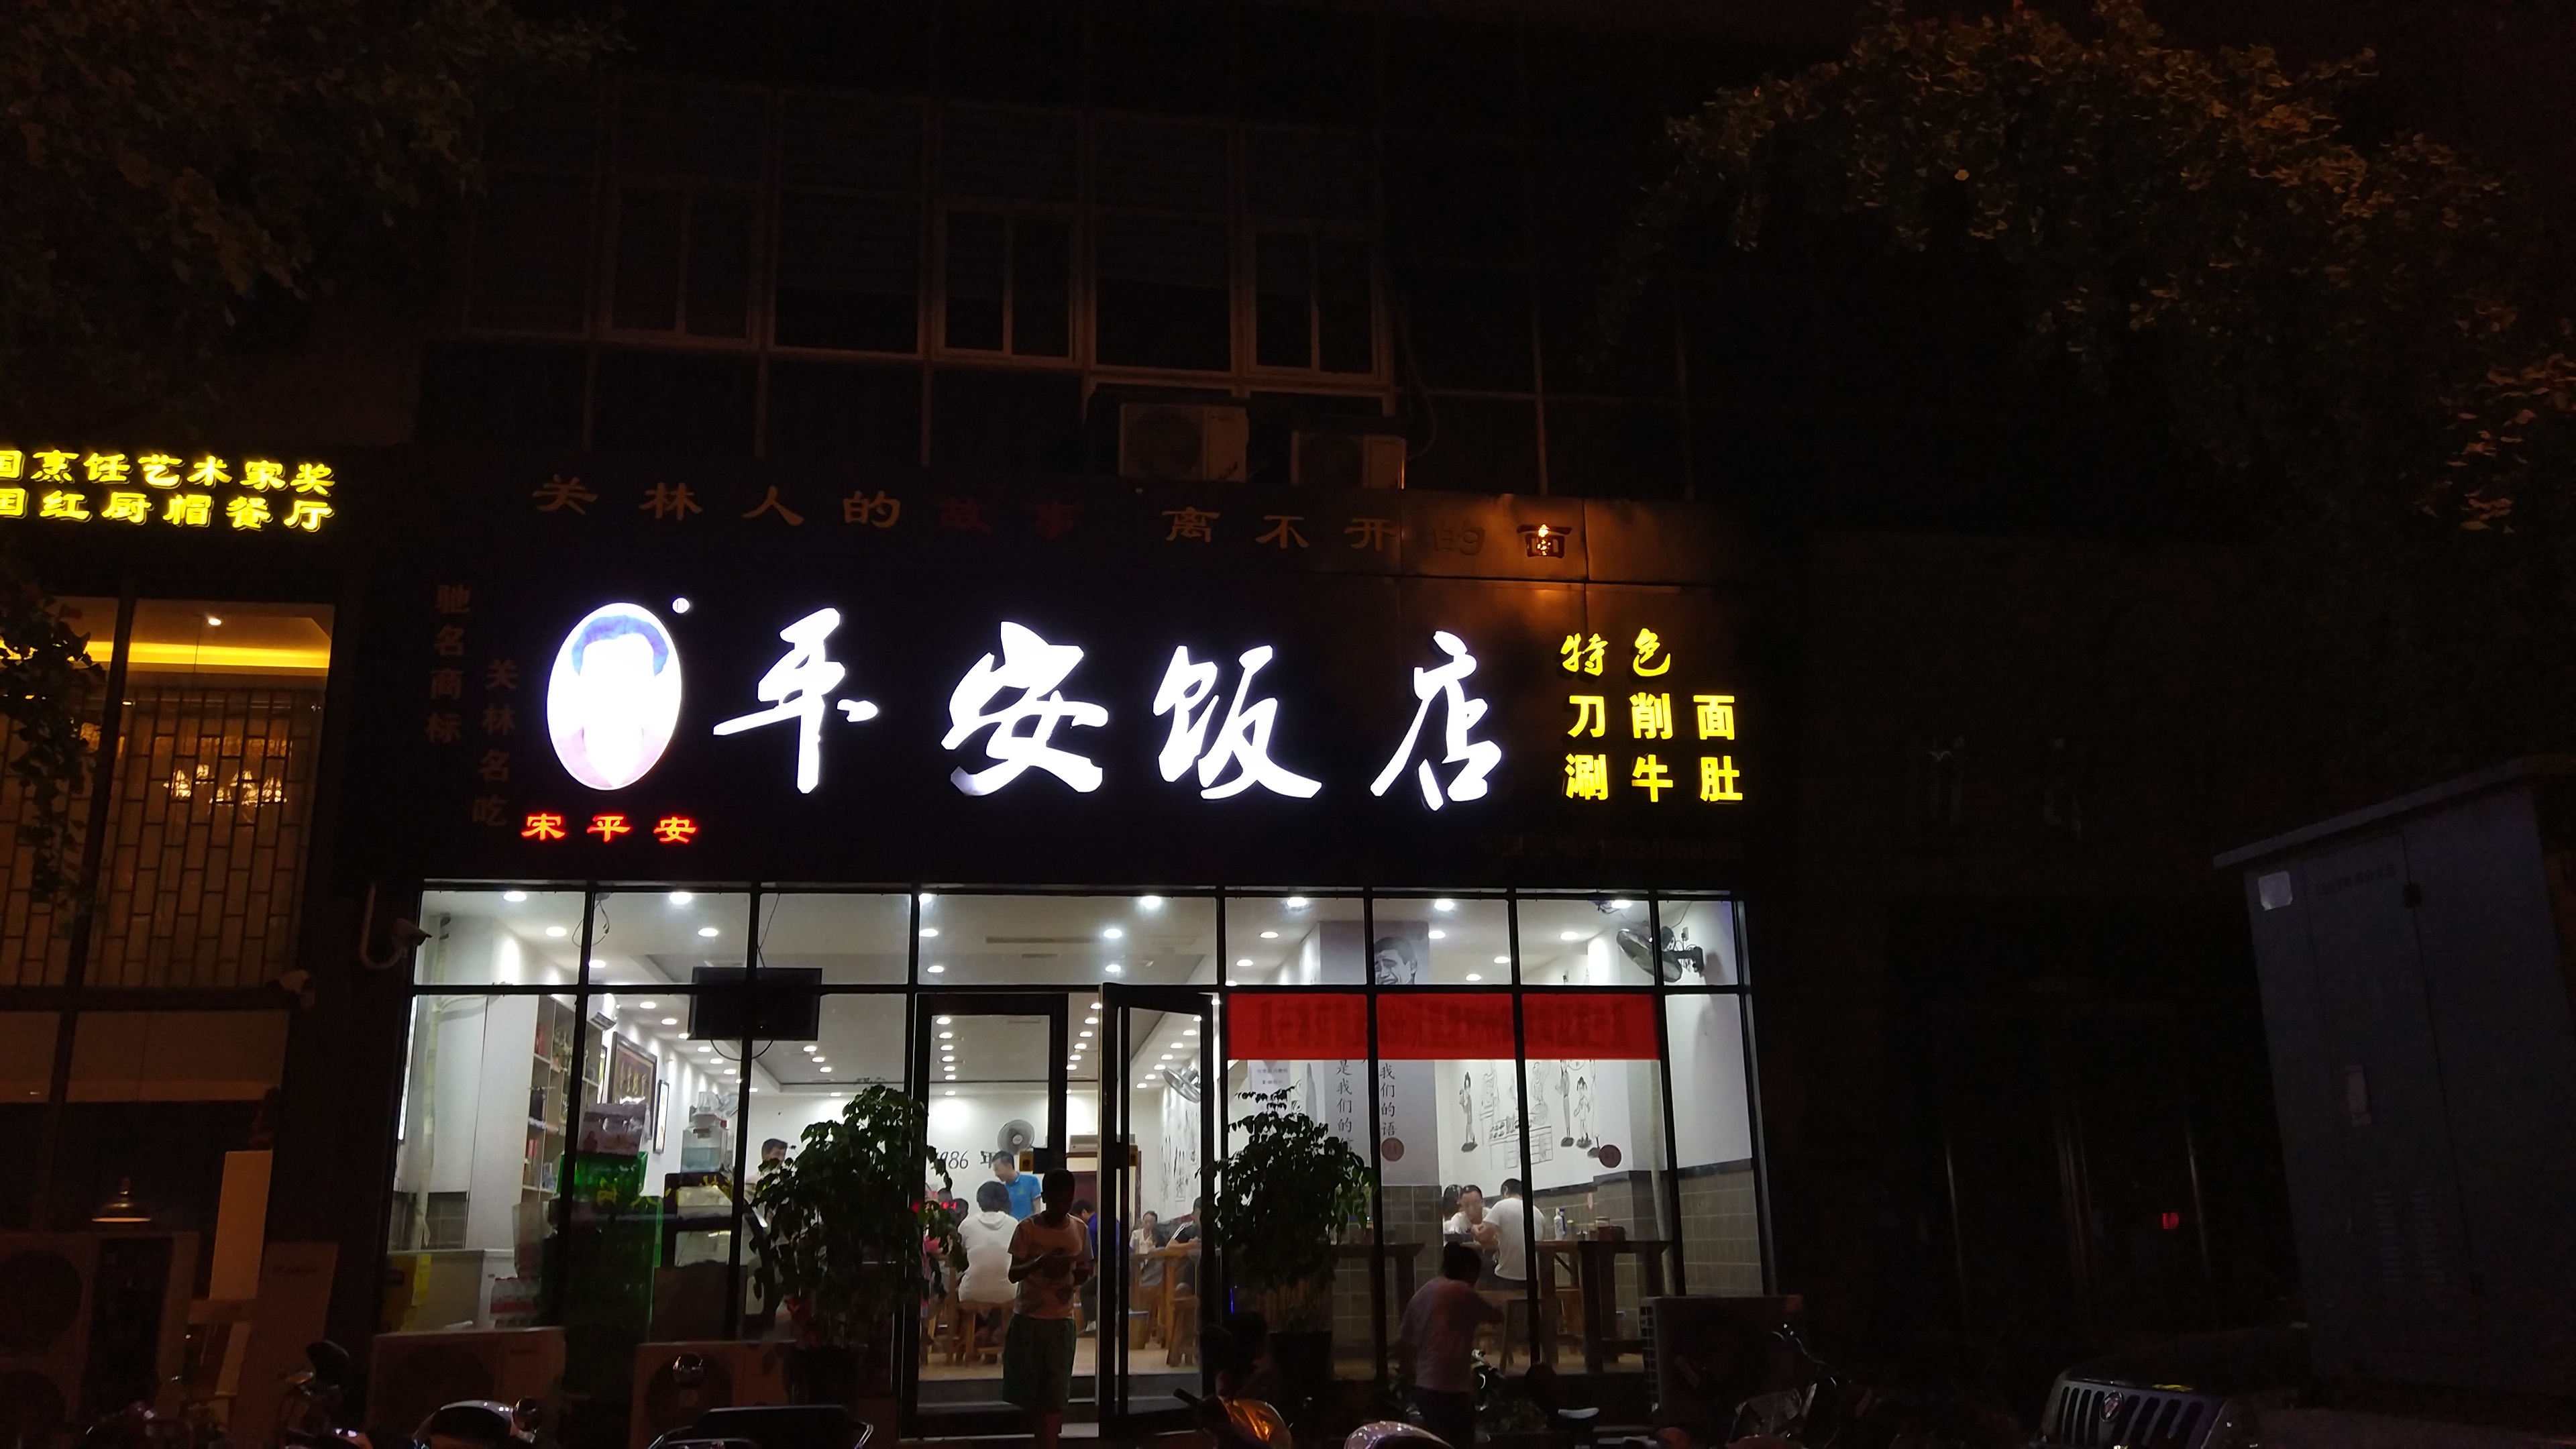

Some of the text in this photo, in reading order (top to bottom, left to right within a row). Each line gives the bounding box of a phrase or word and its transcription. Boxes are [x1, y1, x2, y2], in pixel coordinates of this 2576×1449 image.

[425, 583, 470, 744] 驰名商标
[1560, 628, 1671, 677] 特色
[714, 606, 1502, 810] 平安饭店
[1567, 692, 1735, 741] 刀削面
[472, 659, 519, 828] 关林名吃
[1564, 753, 1743, 803] 涮牛肚
[521, 812, 699, 845] 宋平安
